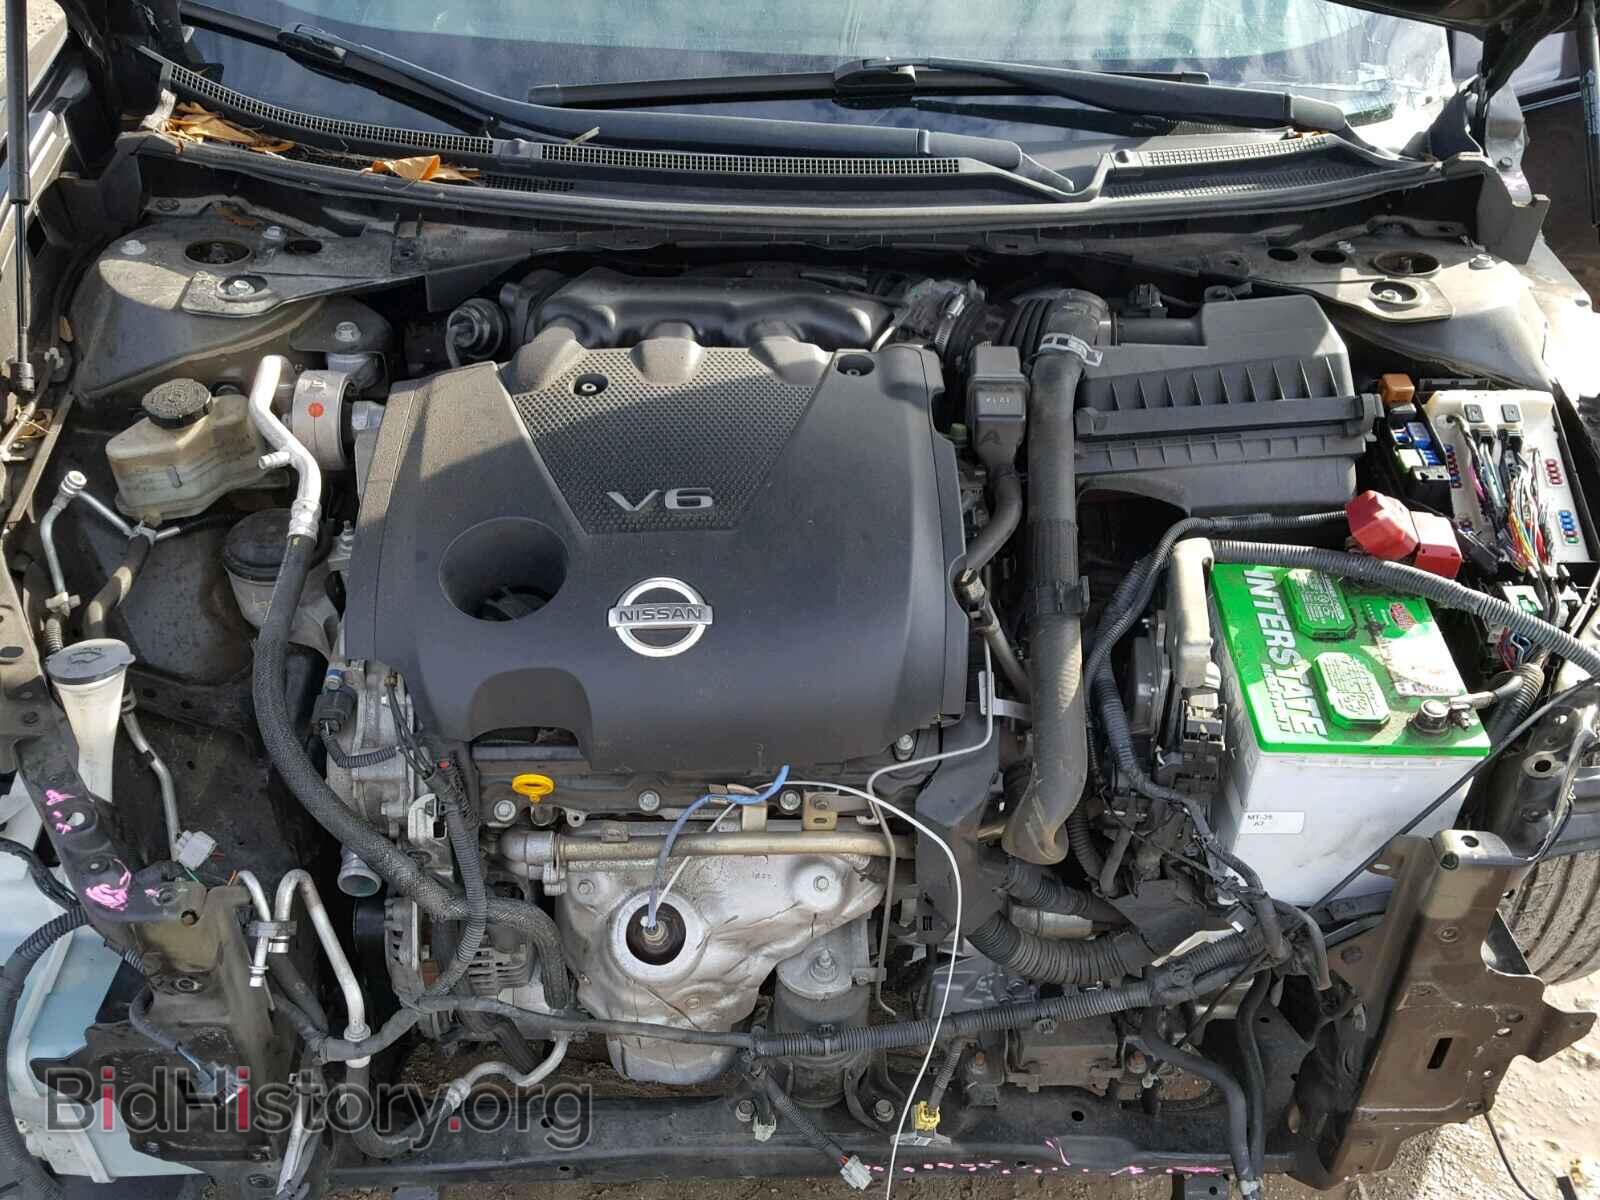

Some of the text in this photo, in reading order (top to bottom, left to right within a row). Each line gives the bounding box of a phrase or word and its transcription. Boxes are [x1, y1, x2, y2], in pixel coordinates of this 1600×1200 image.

[606, 487, 713, 512] V6
[618, 607, 703, 622] NISSAN
[1243, 569, 1329, 737] INTERSTATE
